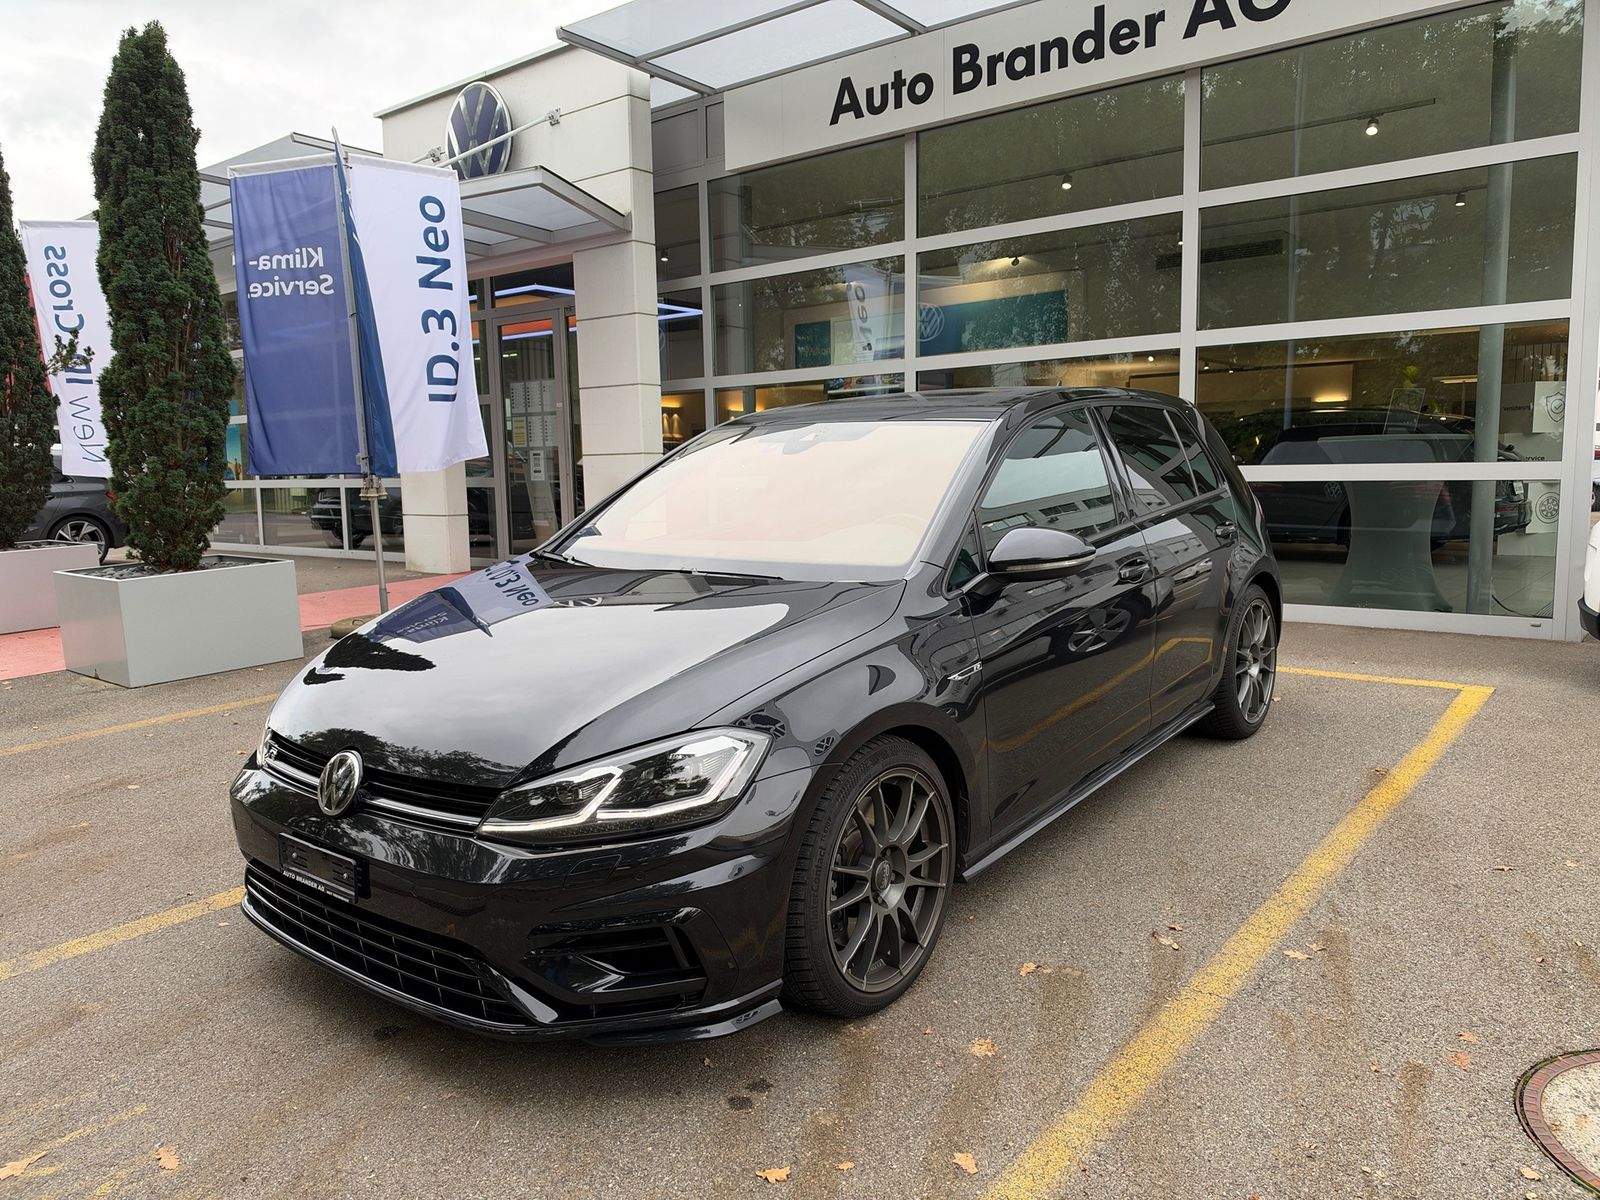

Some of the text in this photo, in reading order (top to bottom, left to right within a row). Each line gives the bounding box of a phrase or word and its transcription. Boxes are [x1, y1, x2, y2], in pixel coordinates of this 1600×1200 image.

[829, 69, 934, 126] Auto
[952, 4, 1166, 95] Brander
[416, 195, 460, 402] ID.3 Neo
[282, 870, 325, 892] AUTO BRANDER AG
